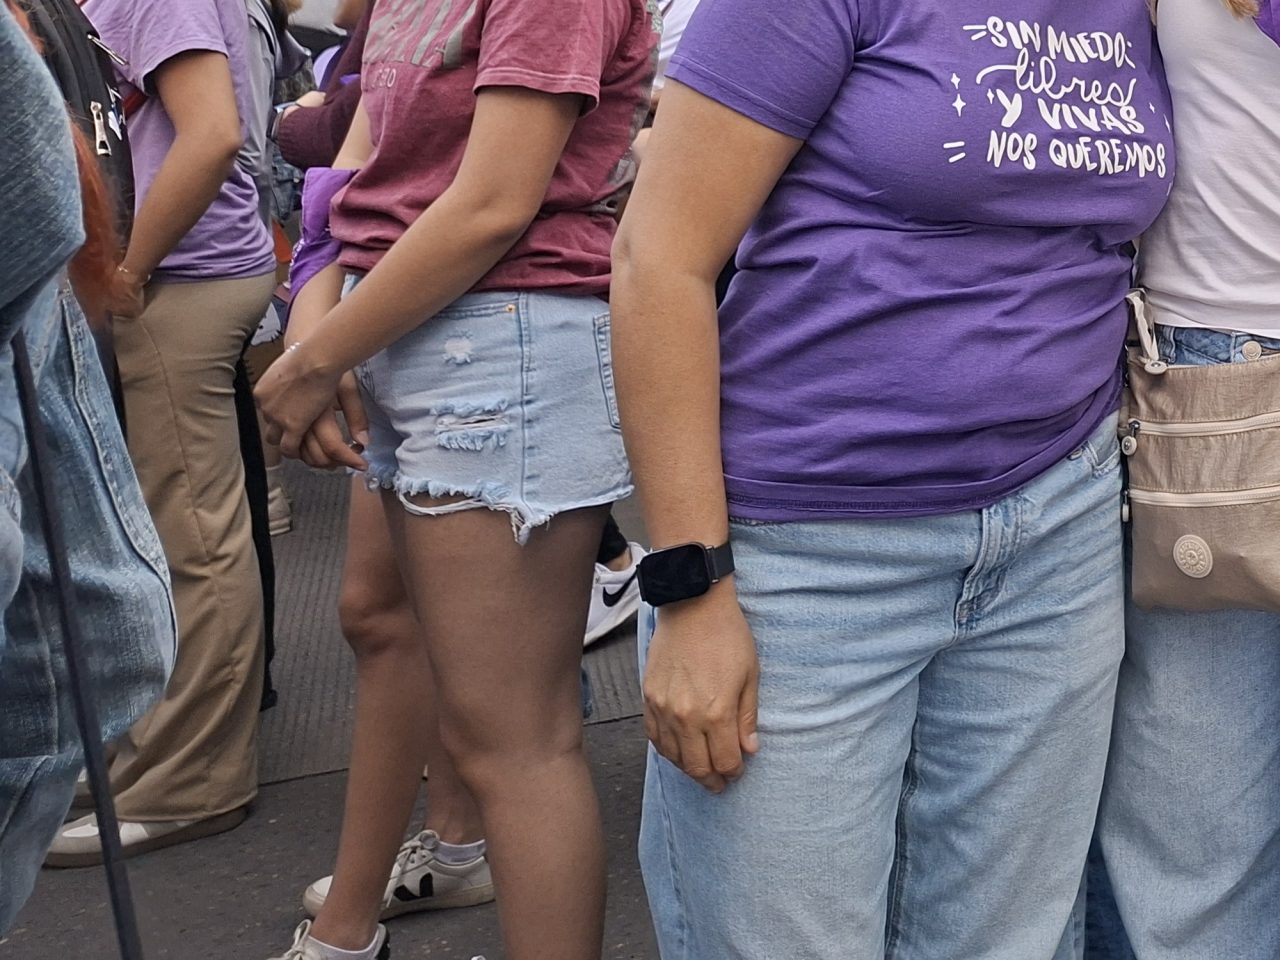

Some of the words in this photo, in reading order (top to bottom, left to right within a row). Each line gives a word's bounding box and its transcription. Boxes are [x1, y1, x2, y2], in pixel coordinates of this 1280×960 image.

[986, 15, 1042, 53] SIN
[1047, 24, 1126, 69] MIEDO
[995, 88, 1023, 128] Y
[1037, 97, 1146, 135] VIVAS
[986, 129, 1038, 171] NOS
[1048, 135, 1167, 179] QUEREMOS
